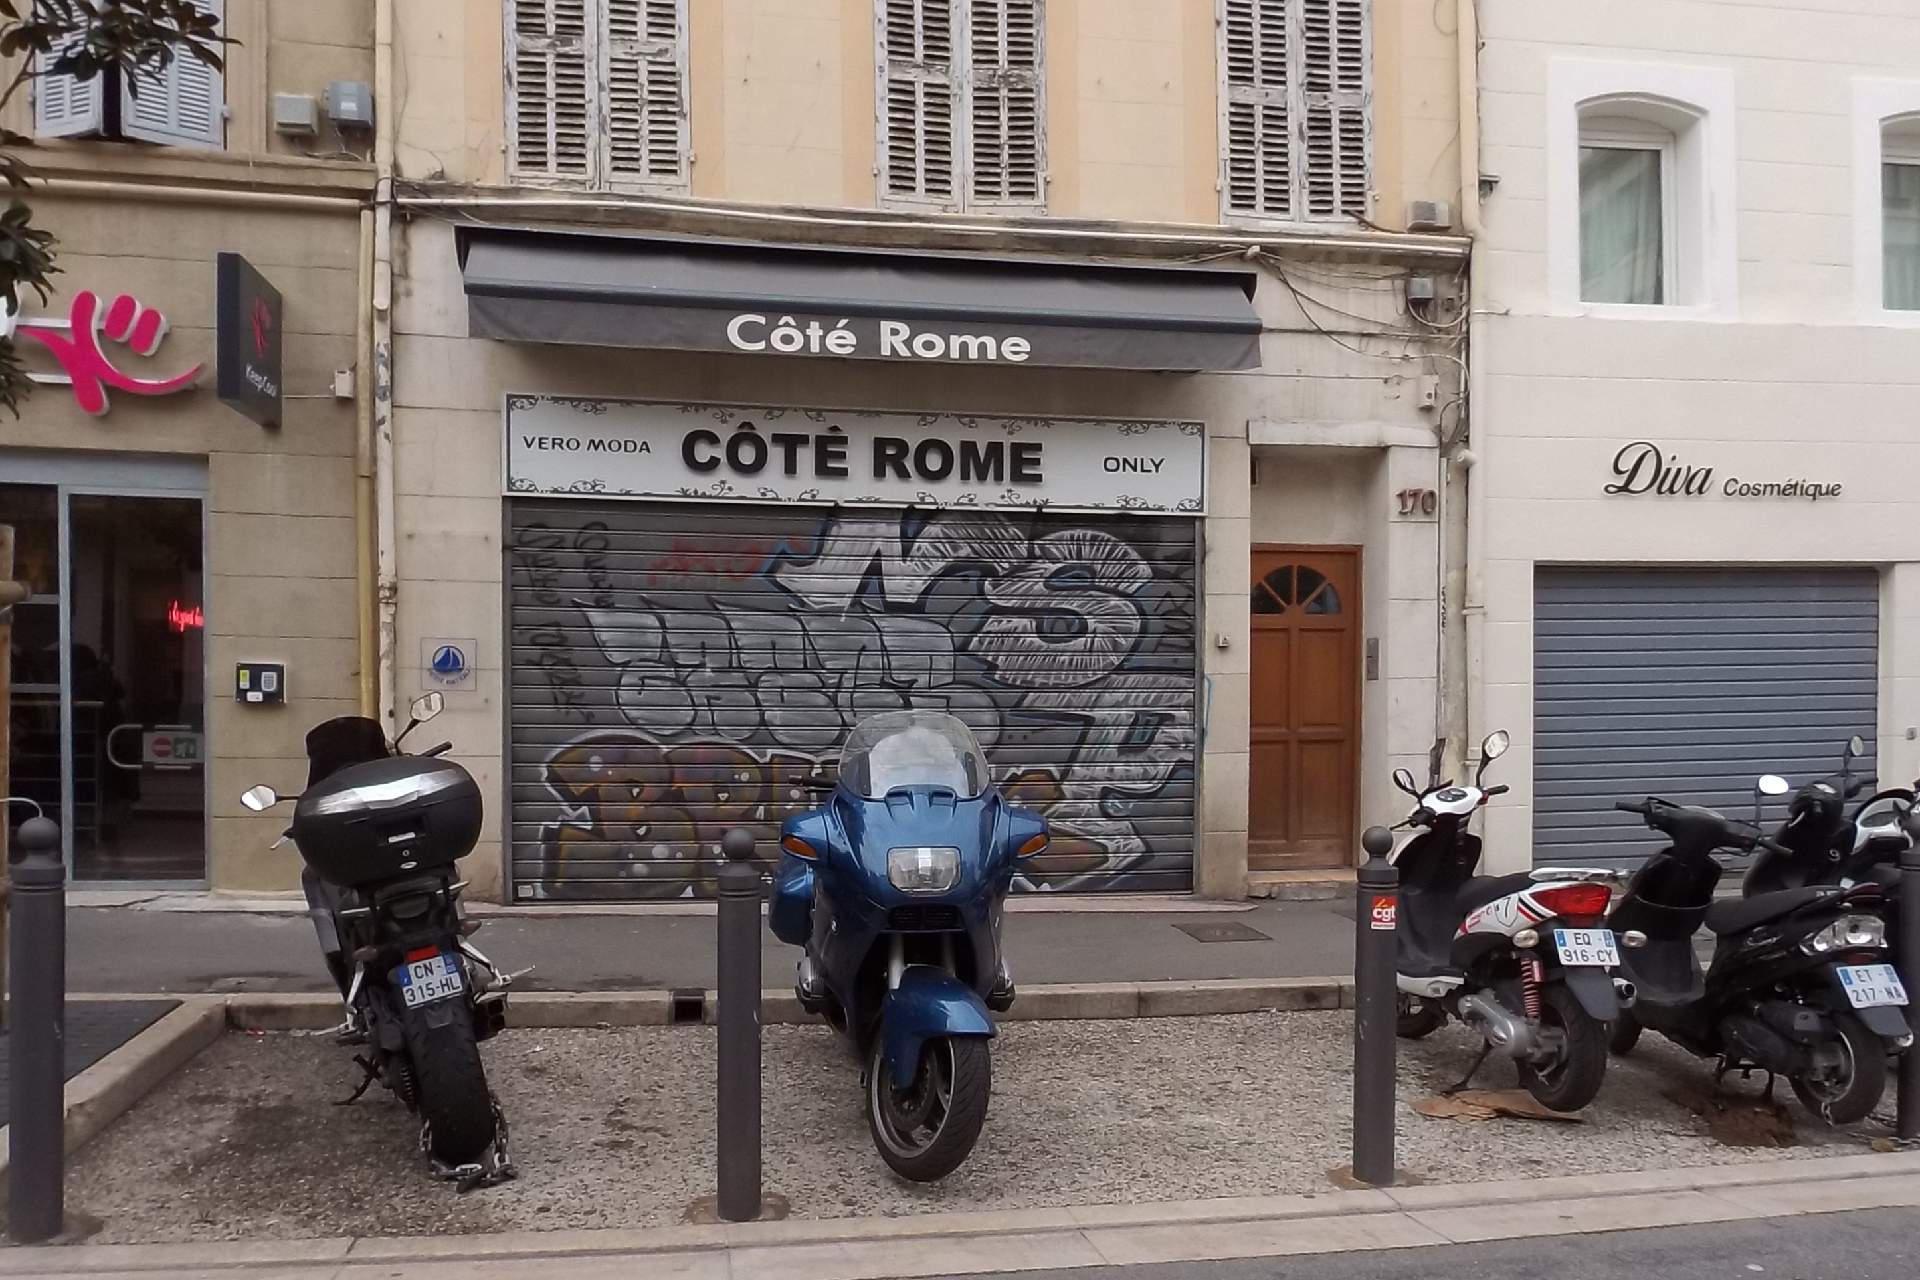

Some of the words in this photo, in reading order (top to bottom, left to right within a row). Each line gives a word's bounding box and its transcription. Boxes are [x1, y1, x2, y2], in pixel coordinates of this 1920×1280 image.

[726, 314, 857, 355] Côté
[880, 320, 1031, 361] Rome
[523, 436, 581, 451] VERO
[586, 438, 651, 454] MODA
[873, 437, 1043, 483] ROME
[1103, 456, 1165, 473] ONLY
[1603, 441, 1713, 496] Diva
[1722, 478, 1842, 501] Cosmétique
[1396, 488, 1437, 515] 170
[405, 977, 460, 1003] 315-HL
